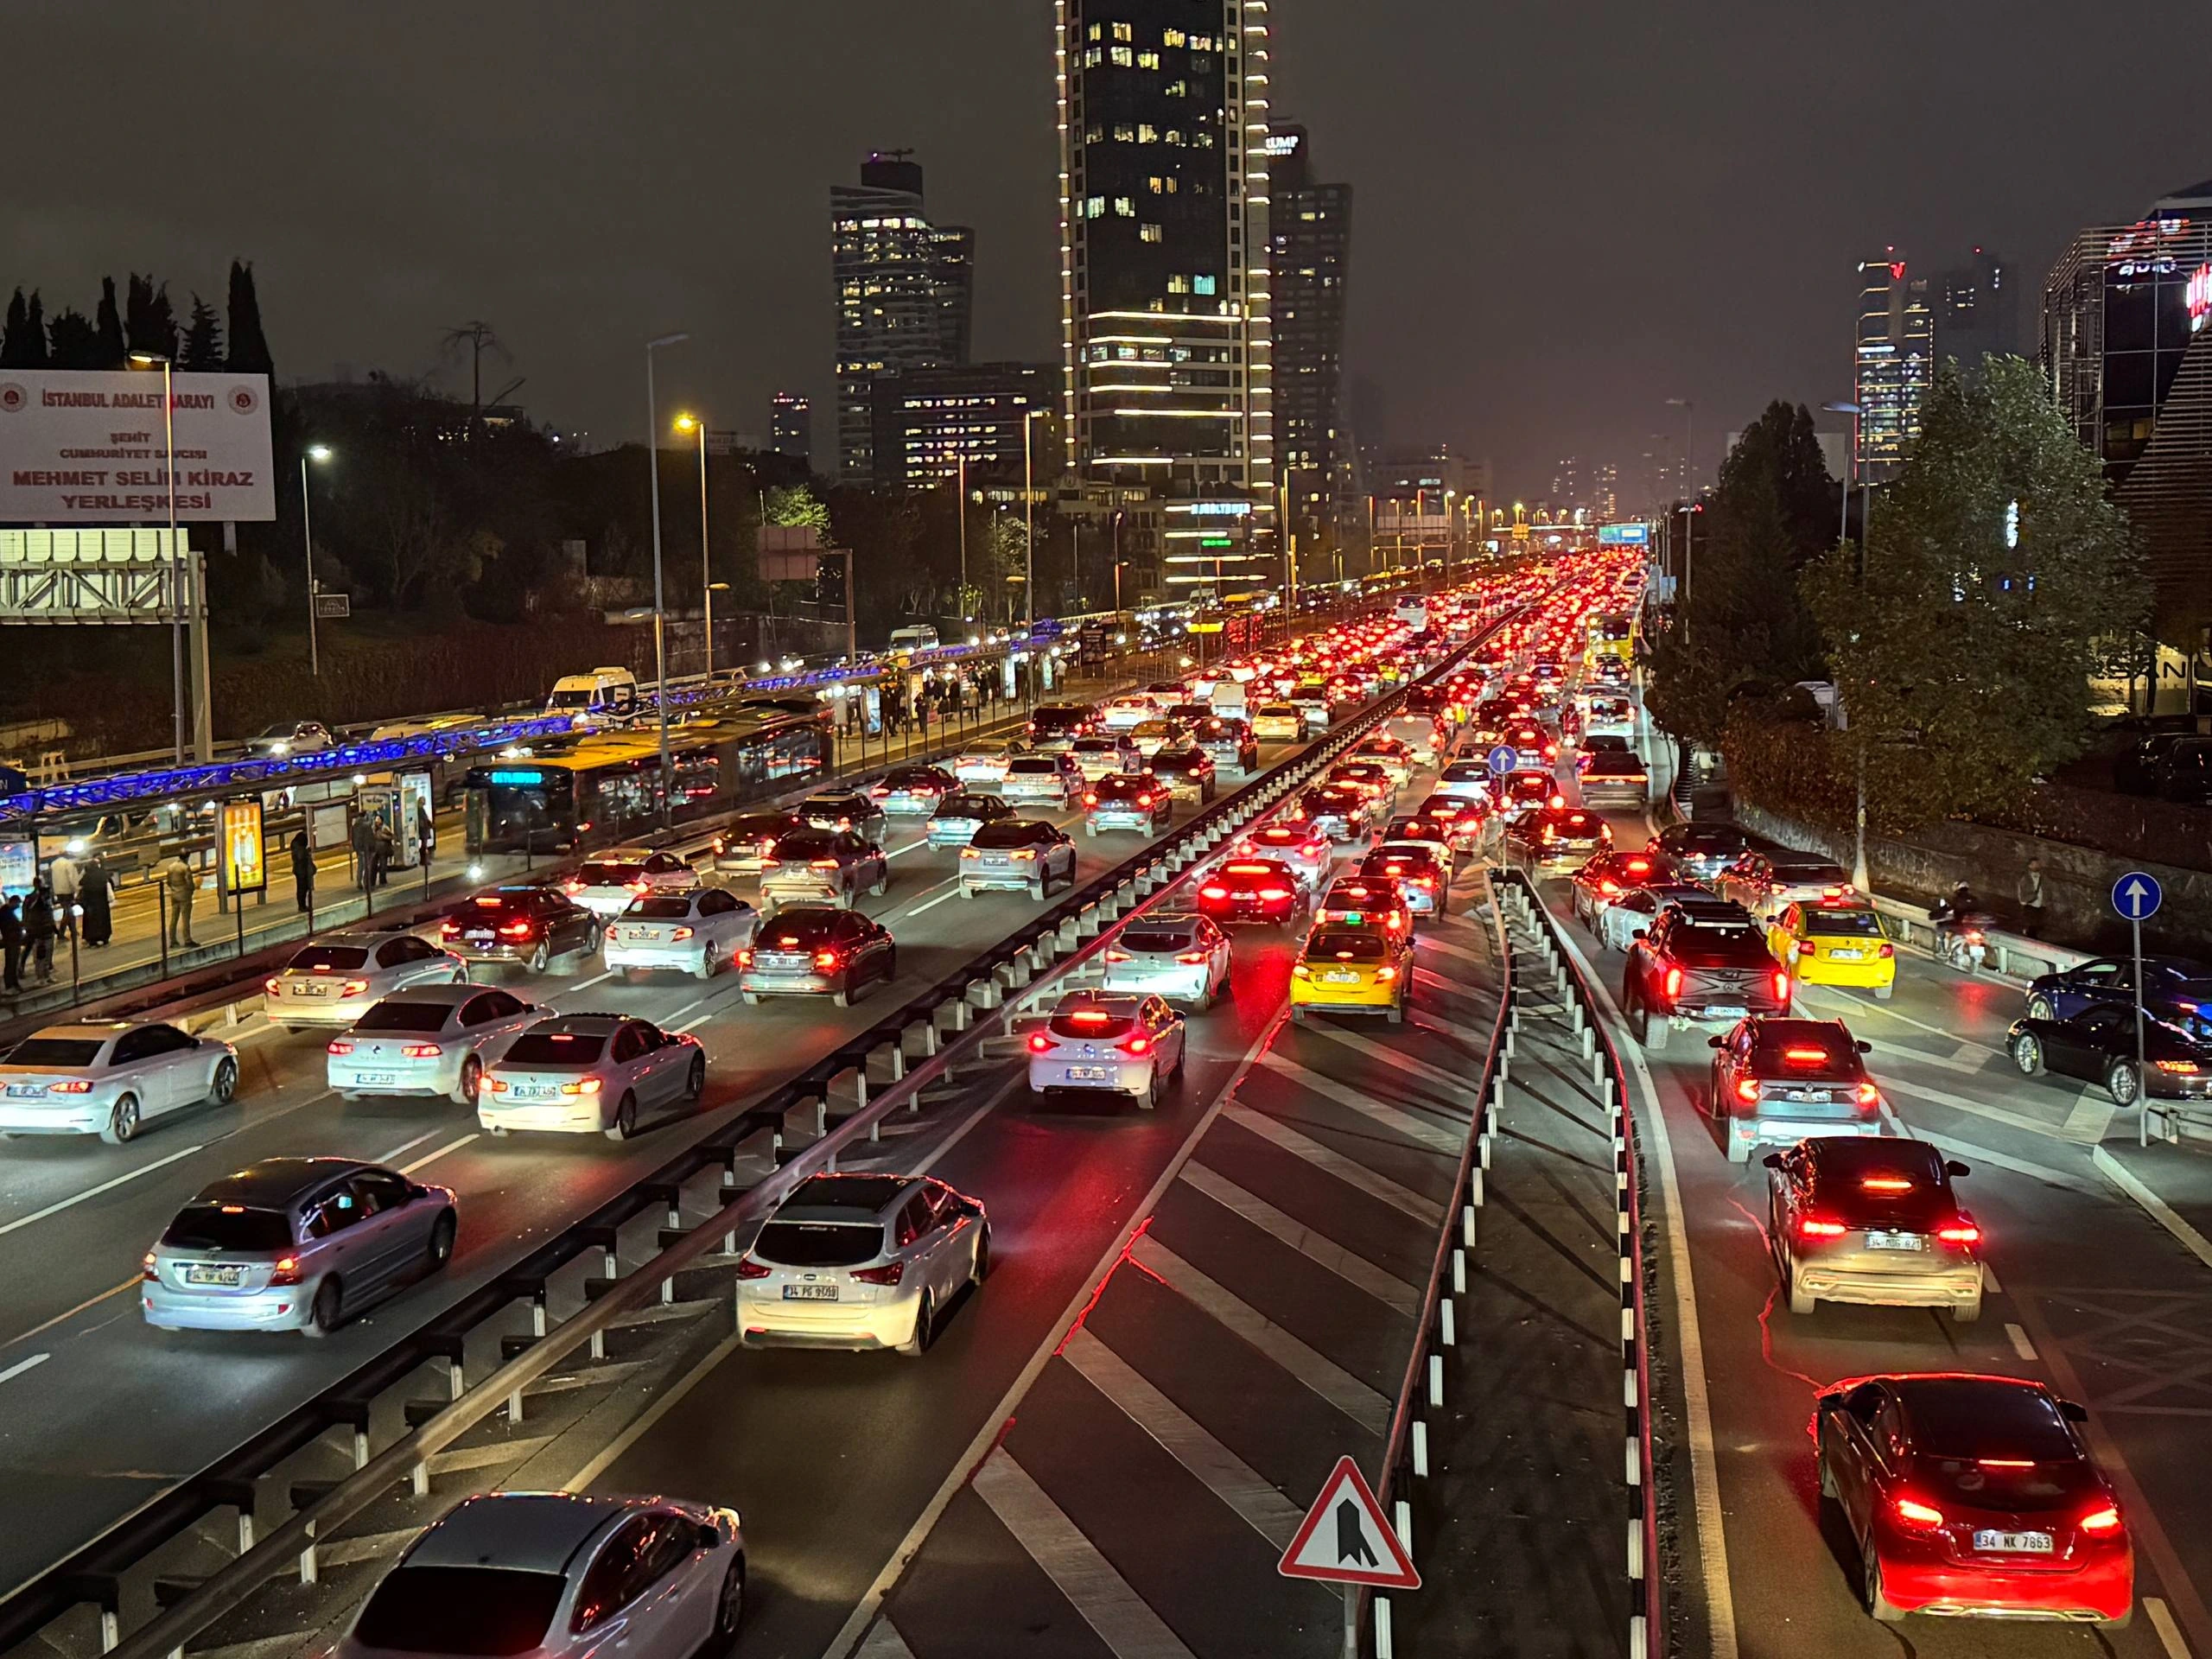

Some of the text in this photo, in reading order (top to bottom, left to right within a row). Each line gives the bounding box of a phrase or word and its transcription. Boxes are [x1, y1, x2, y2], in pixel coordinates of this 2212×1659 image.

[42, 389, 109, 408] İSTANBUL
[112, 394, 162, 409] ADALET
[111, 432, 151, 445] ŞEHİT
[60, 448, 150, 459] CUMHURİYET
[13, 468, 254, 486] MEHMET SELİM KİRAZ
[1982, 1535, 1995, 1548] 34
[2004, 1535, 2016, 1548] NK
